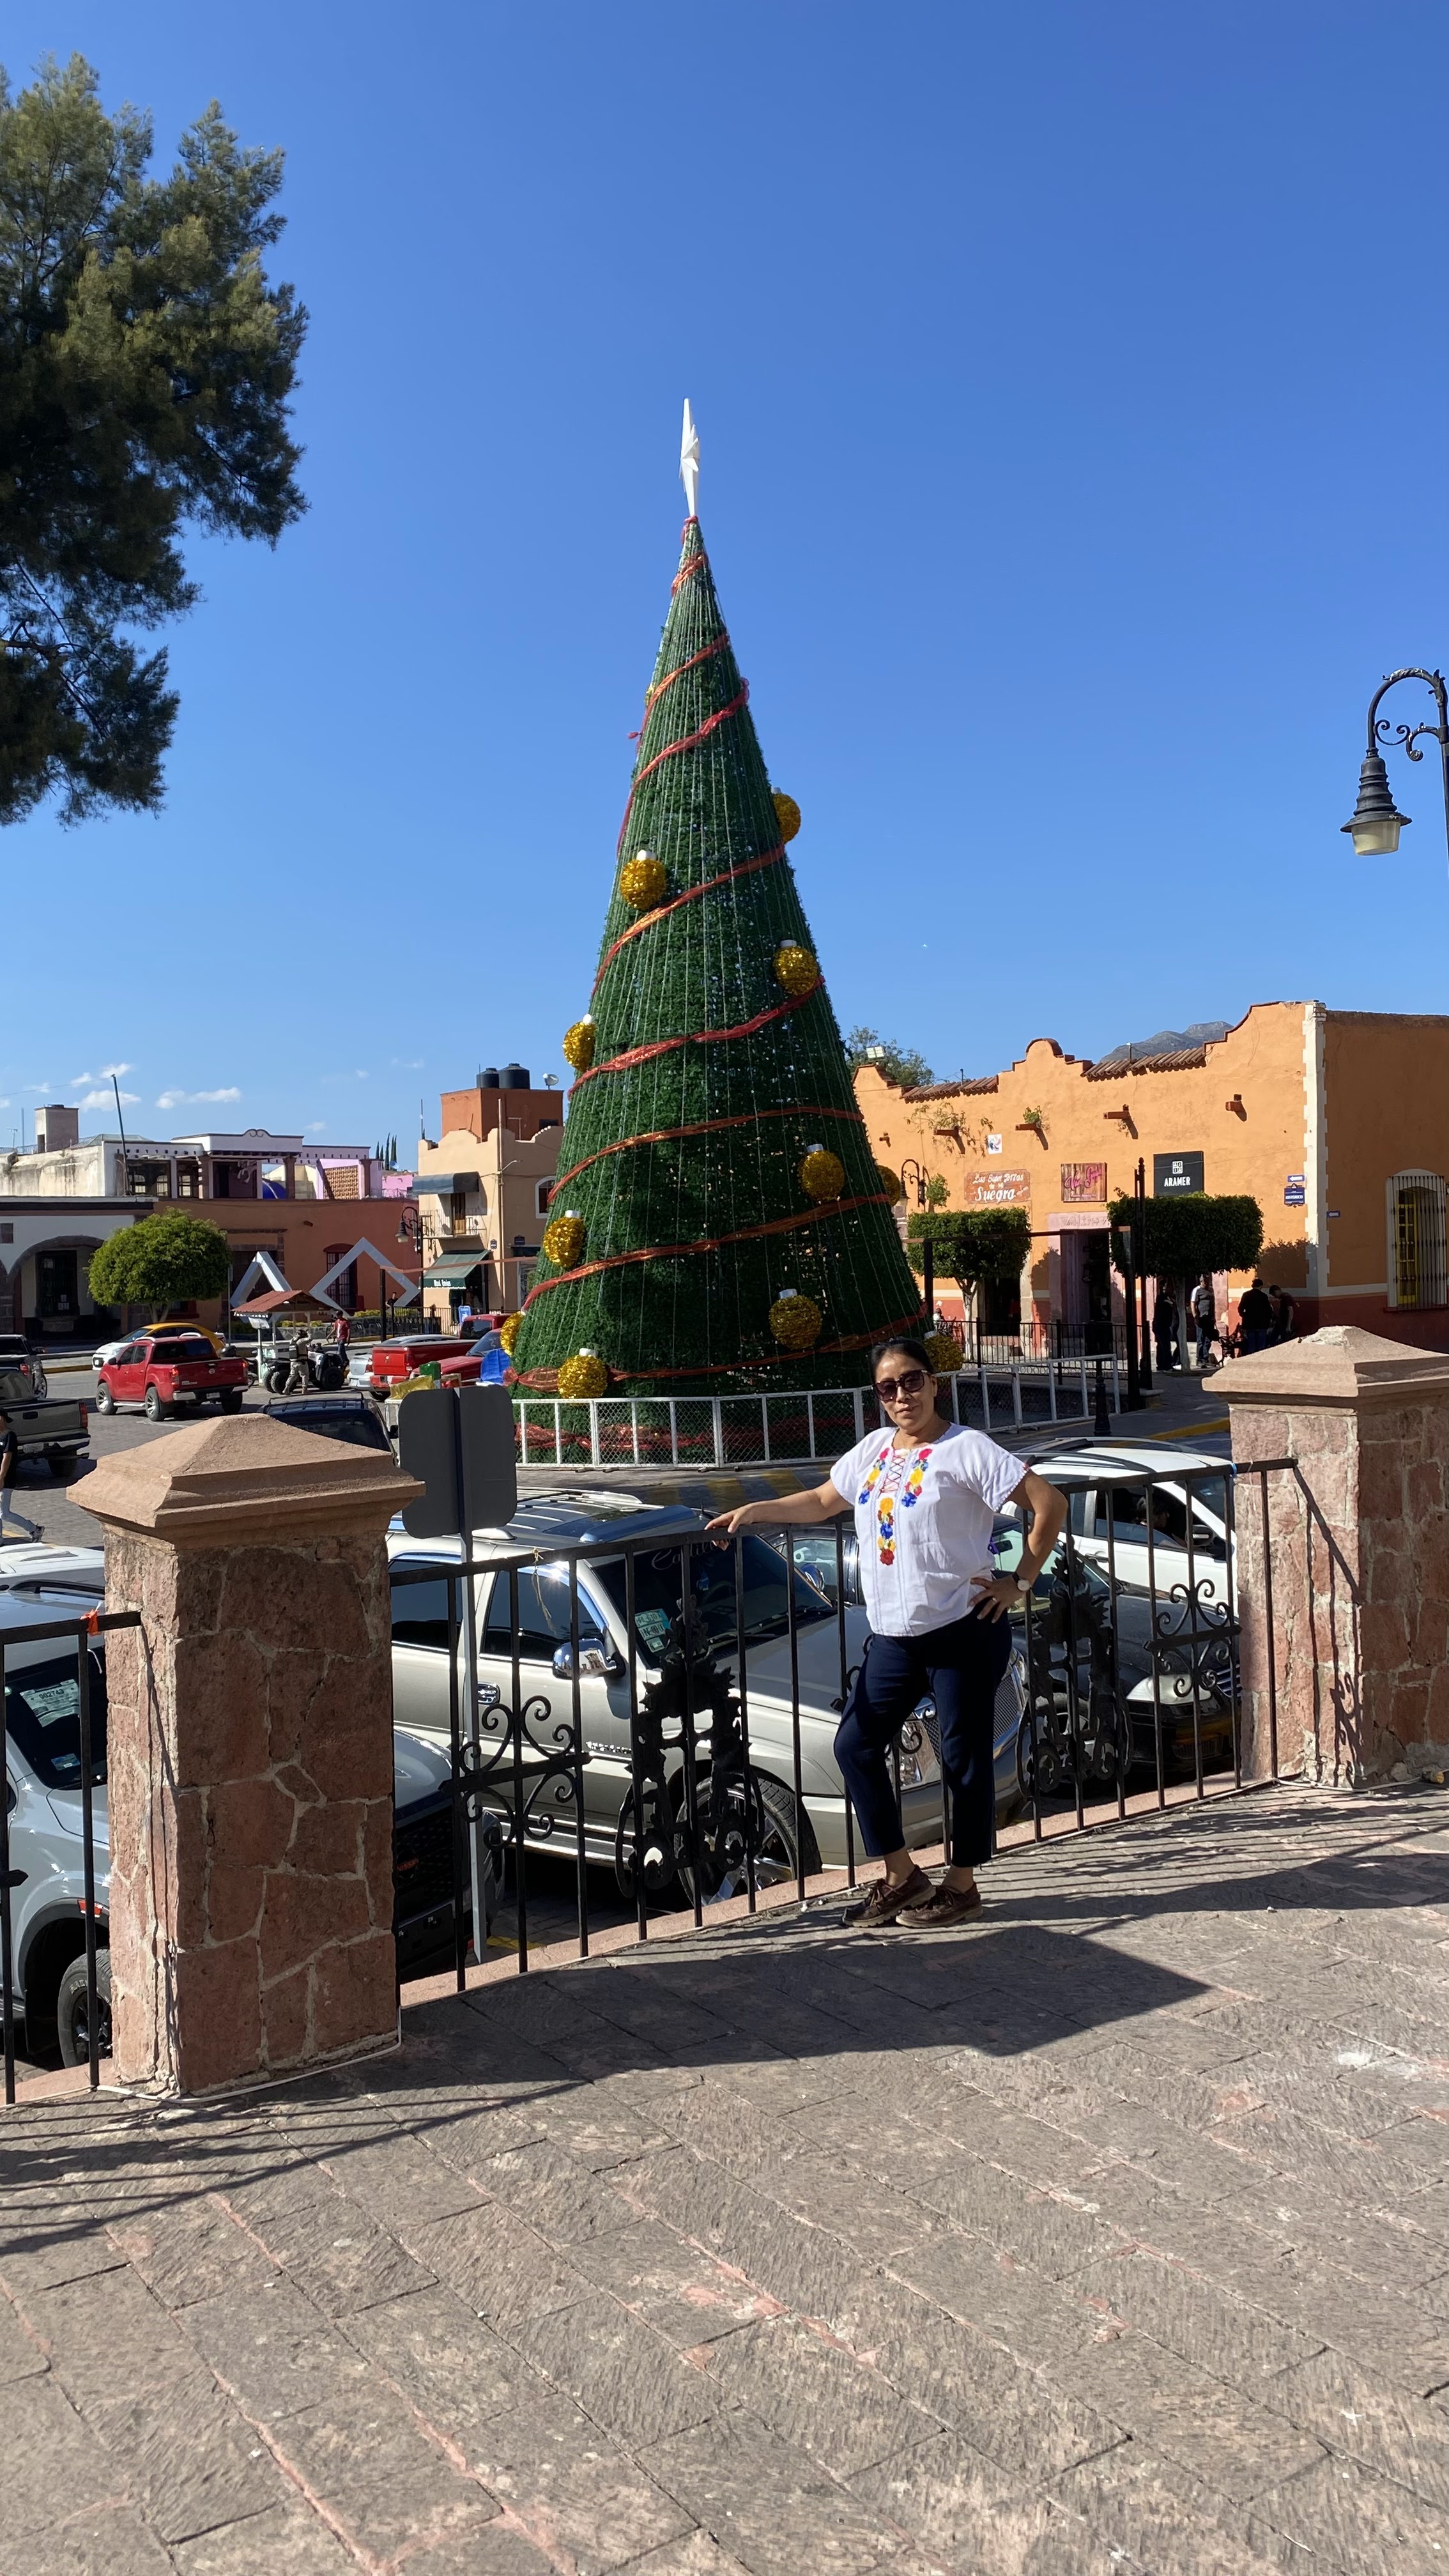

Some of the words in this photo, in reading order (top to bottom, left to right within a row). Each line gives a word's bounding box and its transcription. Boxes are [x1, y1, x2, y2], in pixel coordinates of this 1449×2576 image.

[1164, 1176, 1190, 1186] ARAMER
[974, 1186, 1016, 1202] Suegra
[39, 1689, 64, 1699] 002743
